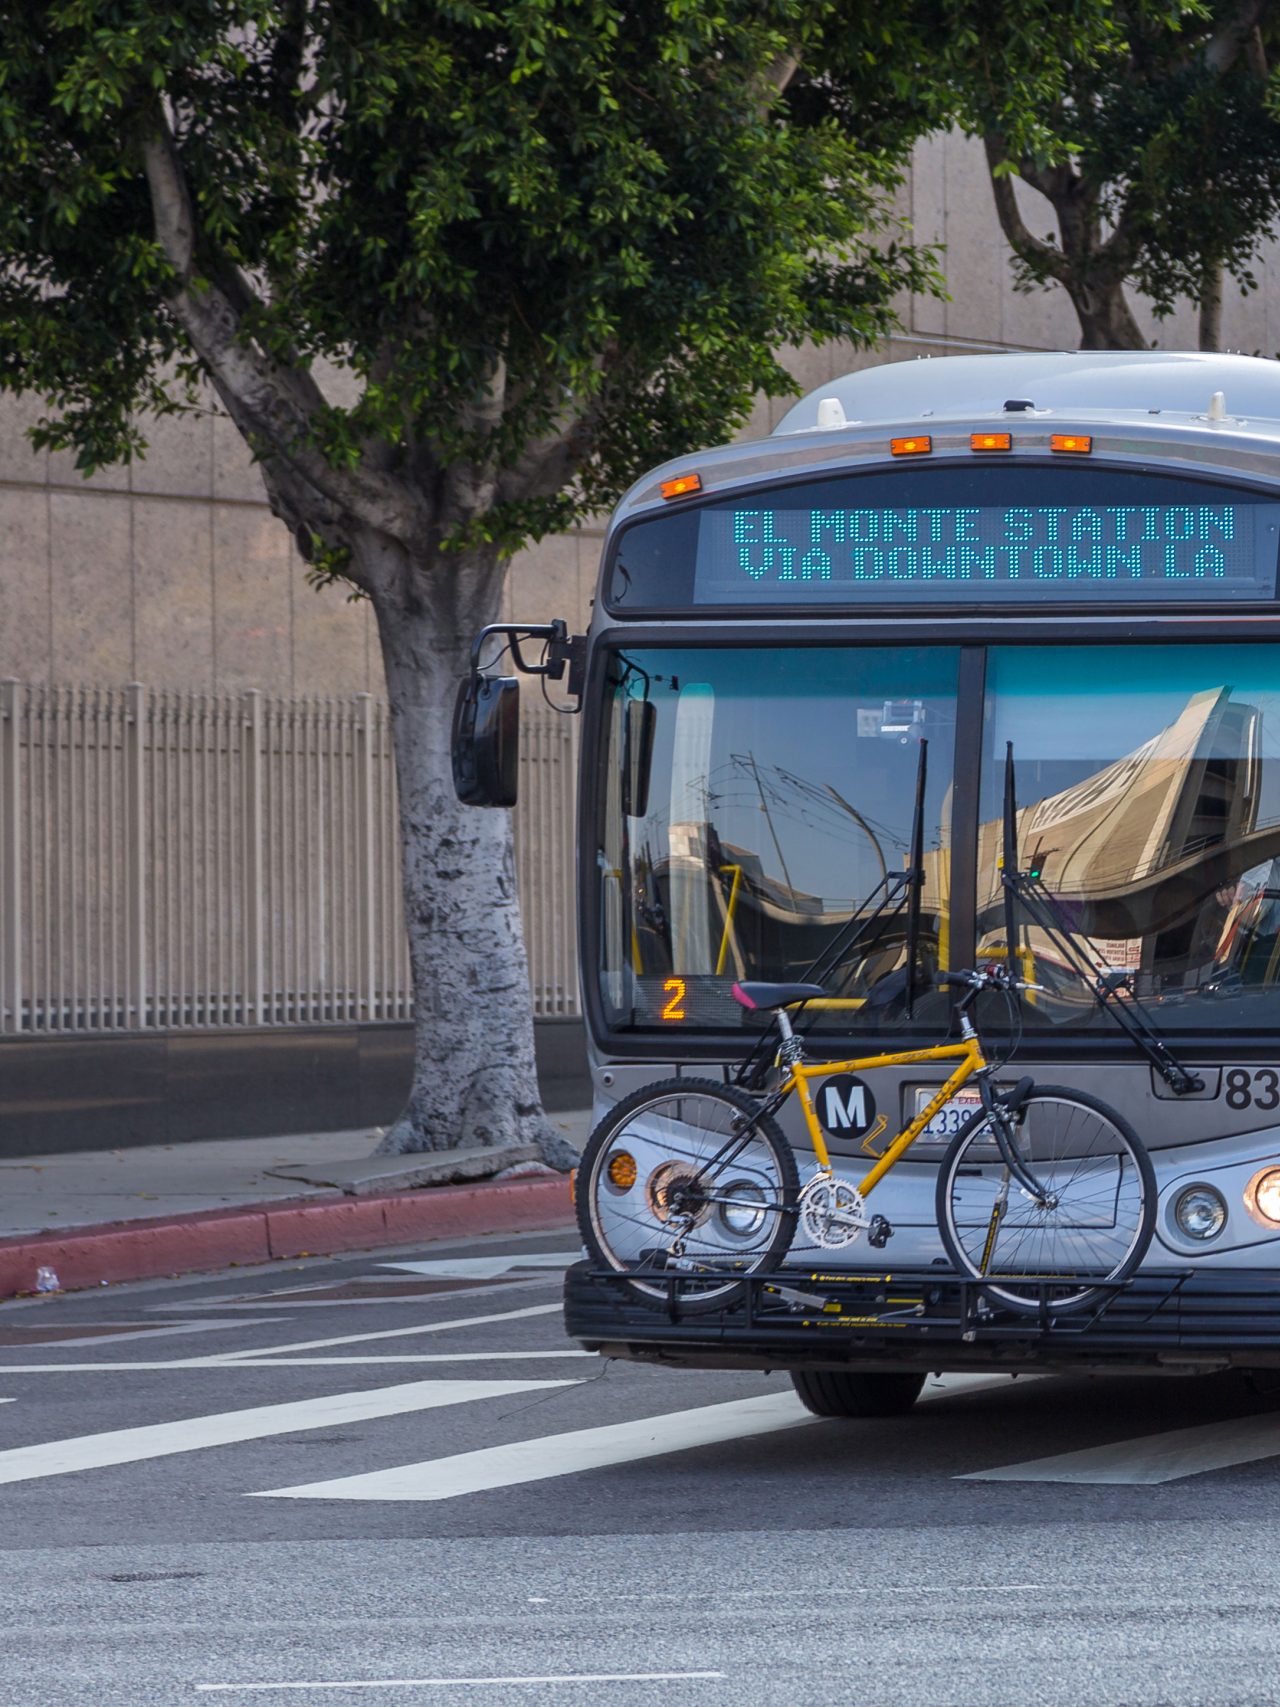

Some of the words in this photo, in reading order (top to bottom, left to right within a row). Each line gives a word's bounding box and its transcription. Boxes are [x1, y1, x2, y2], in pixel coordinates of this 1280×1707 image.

[734, 510, 788, 544] EL
[811, 508, 981, 543] MONTE
[1003, 506, 1236, 542] STATION
[739, 547, 832, 581] VIA
[853, 545, 1142, 580] DOWNTOWN
[1165, 544, 1226, 578] LA
[663, 978, 686, 1020] 2
[825, 1085, 867, 1128] M
